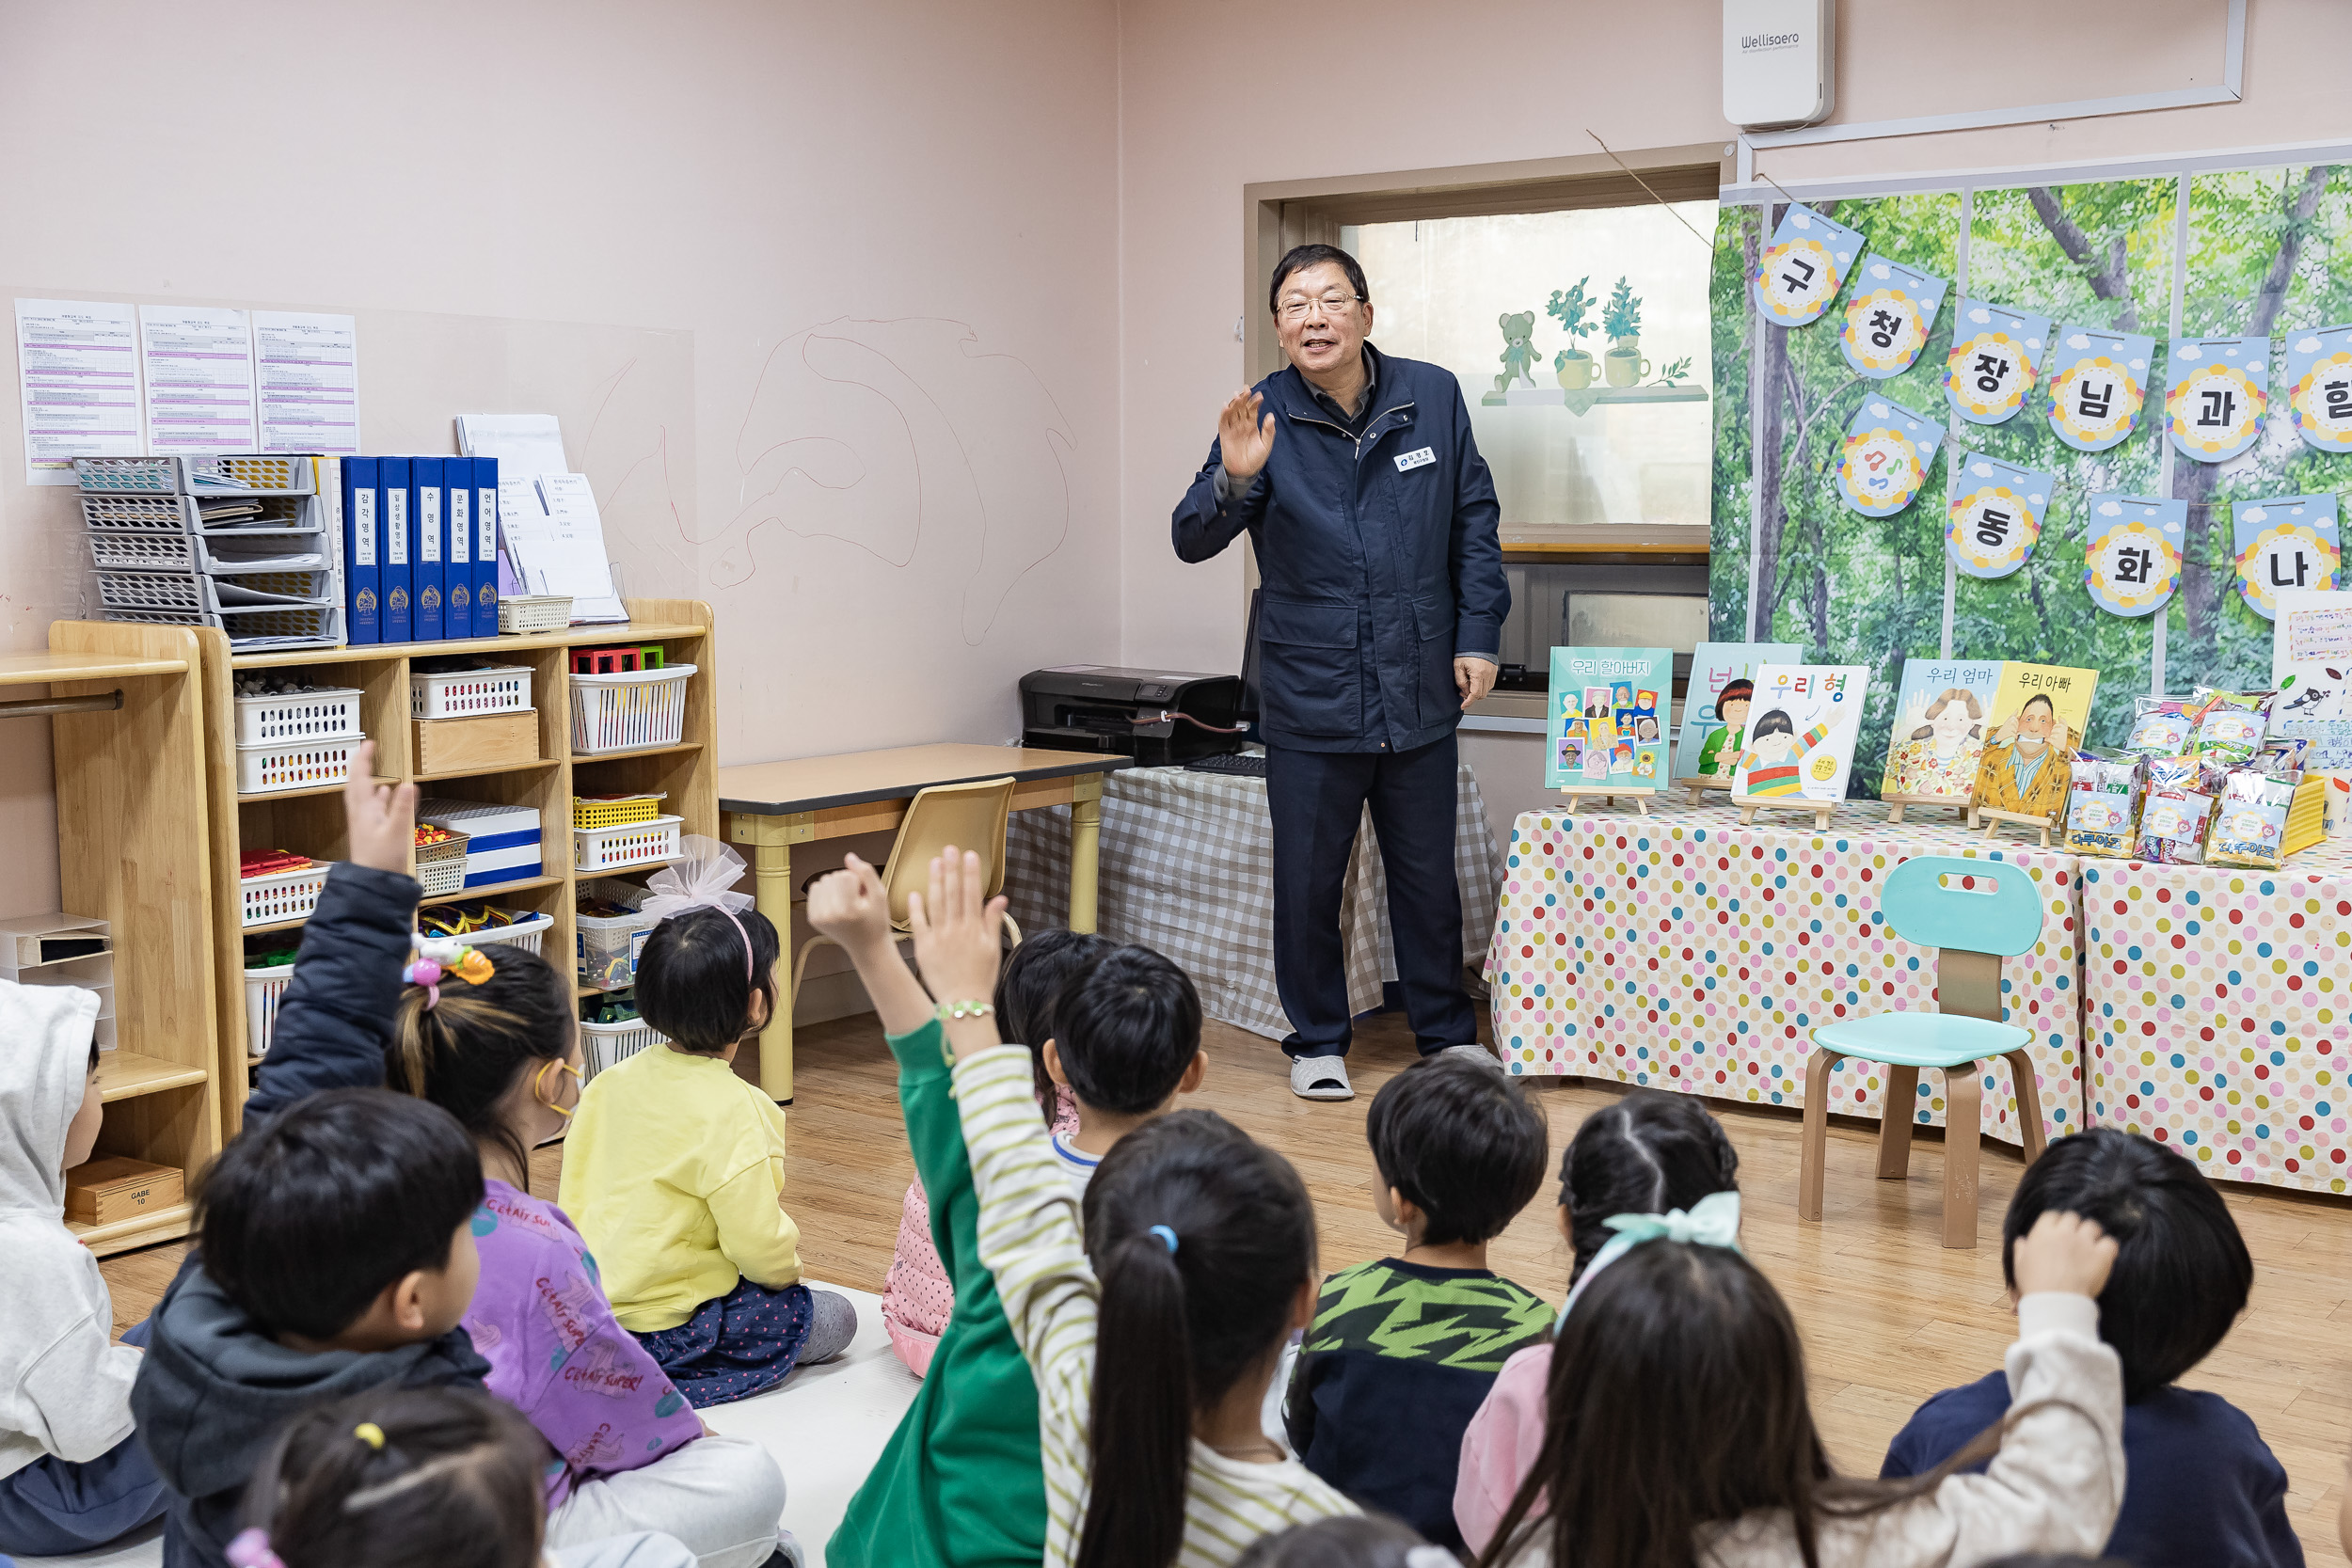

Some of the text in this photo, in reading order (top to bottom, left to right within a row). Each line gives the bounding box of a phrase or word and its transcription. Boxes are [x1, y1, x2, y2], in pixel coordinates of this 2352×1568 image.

[1741, 33, 1799, 48] Wellisaero
[1782, 258, 1816, 293] 구
[1869, 309, 1902, 349] 청
[1973, 354, 2010, 392] 장
[2078, 379, 2111, 418] 님
[2197, 389, 2236, 428] 과
[361, 494, 370, 547] 감각영역
[1977, 508, 2310, 588] 동 화 나
[1572, 659, 1650, 675] 우리 할아버지
[1927, 667, 1994, 685] 우리 엄마
[1771, 673, 1848, 704] 우리 형
[2019, 672, 2072, 693] 우리 아빠
[2072, 833, 2122, 849] 다쿠아즈
[131, 1189, 150, 1199] GABE
